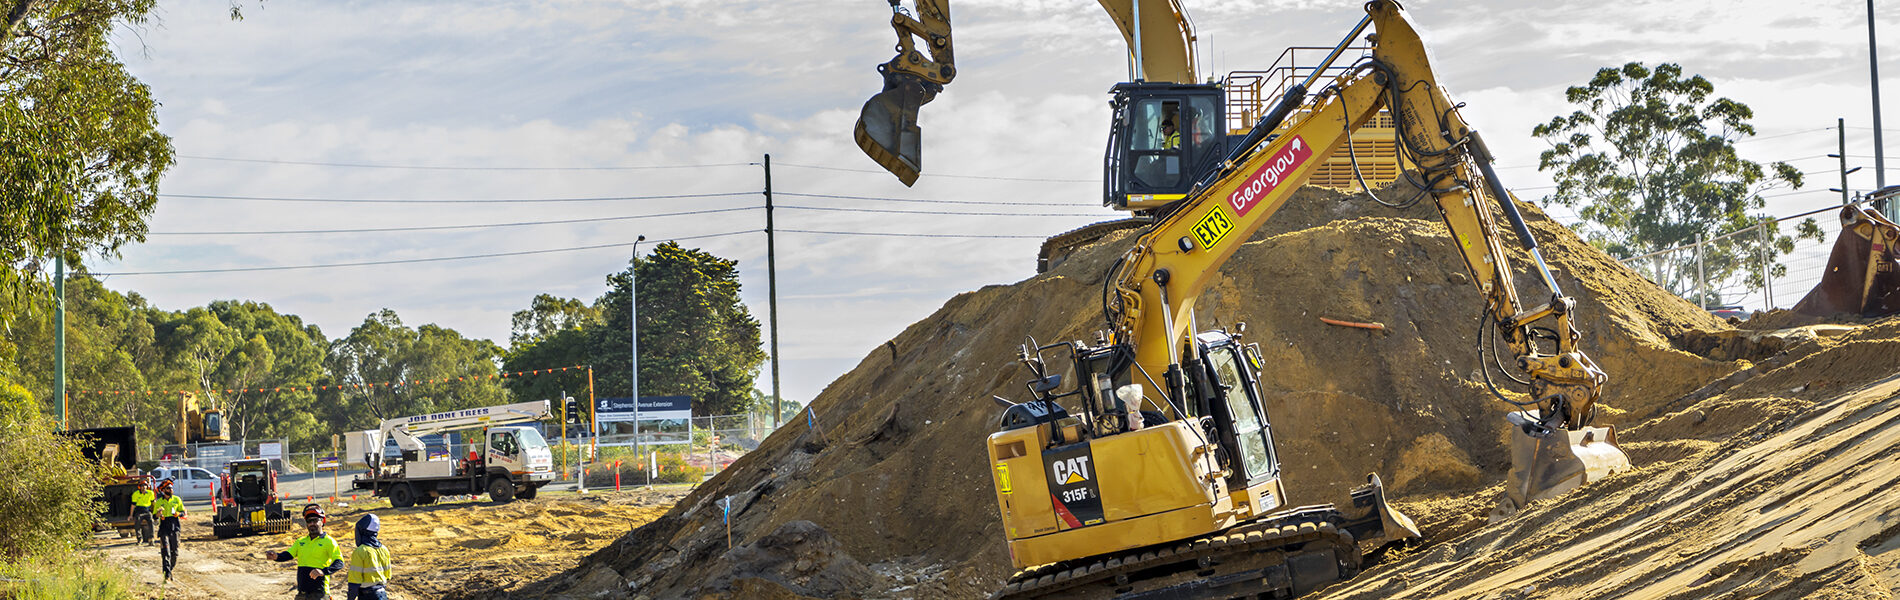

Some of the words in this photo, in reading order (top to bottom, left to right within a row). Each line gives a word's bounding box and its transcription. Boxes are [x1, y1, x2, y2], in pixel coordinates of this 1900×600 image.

[1232, 147, 1295, 211] Georgiou
[1196, 211, 1229, 245] EX73
[408, 415, 427, 423] JOB
[430, 412, 456, 420] DONE
[460, 408, 489, 417] TREES
[1053, 456, 1090, 485] CAT
[1062, 487, 1088, 503] 315F
